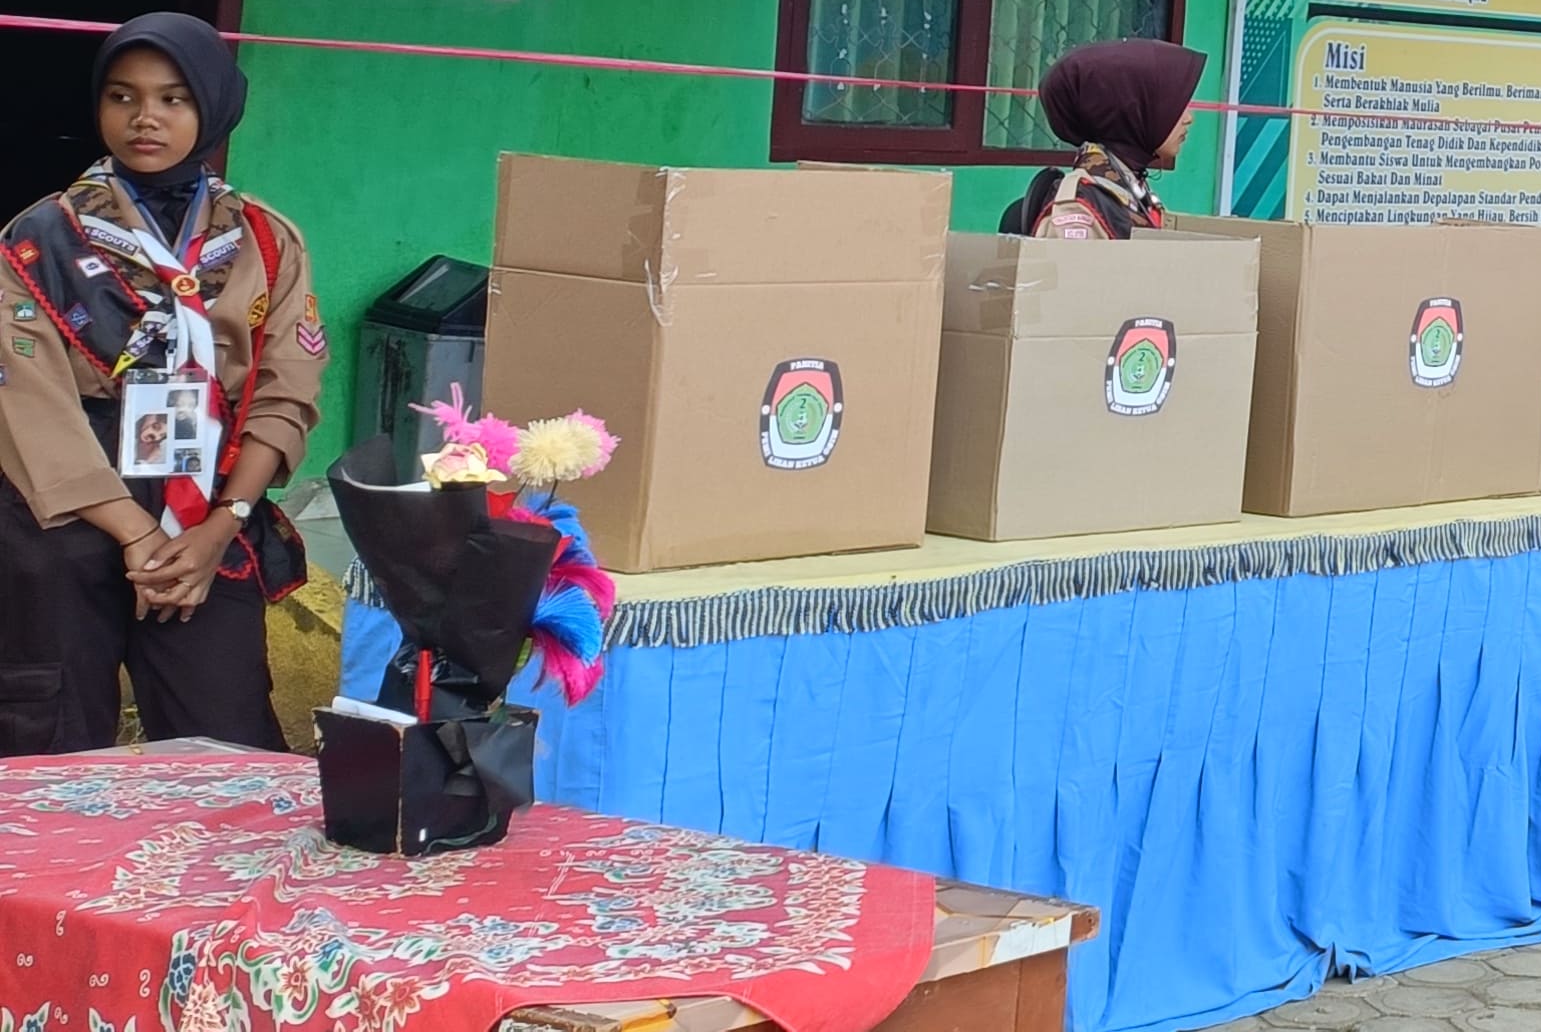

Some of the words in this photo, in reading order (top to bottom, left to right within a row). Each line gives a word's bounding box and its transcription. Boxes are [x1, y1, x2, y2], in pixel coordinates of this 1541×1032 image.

[1325, 42, 1366, 71] Misi
[1324, 74, 1387, 92] Membentuk
[1390, 78, 1433, 95] Manusia
[1435, 81, 1460, 98] Yang
[1323, 94, 1352, 109] Serta
[1355, 96, 1409, 112] Berakhlak
[1412, 98, 1441, 114] Mulia
[1320, 132, 1402, 151] Pengembangan
[1405, 134, 1434, 152] Tenag
[1437, 136, 1465, 150] Didik
[1467, 137, 1487, 151] Dan
[1319, 151, 1376, 167] Membantu
[1378, 153, 1409, 167] Siswa
[1411, 154, 1443, 168] Untuk
[1445, 154, 1527, 172] Mengembangkan
[1317, 170, 1353, 185] Sesuai
[1356, 171, 1388, 186] Bakat
[1390, 171, 1411, 186] Dan
[1413, 172, 1443, 187] Minat
[1317, 189, 1350, 205] Dapat
[1352, 190, 1420, 206] Menjalankan
[1477, 190, 1516, 205] Standar
[1316, 208, 1385, 225] Menciptakan
[1509, 209, 1539, 223] Bersih
